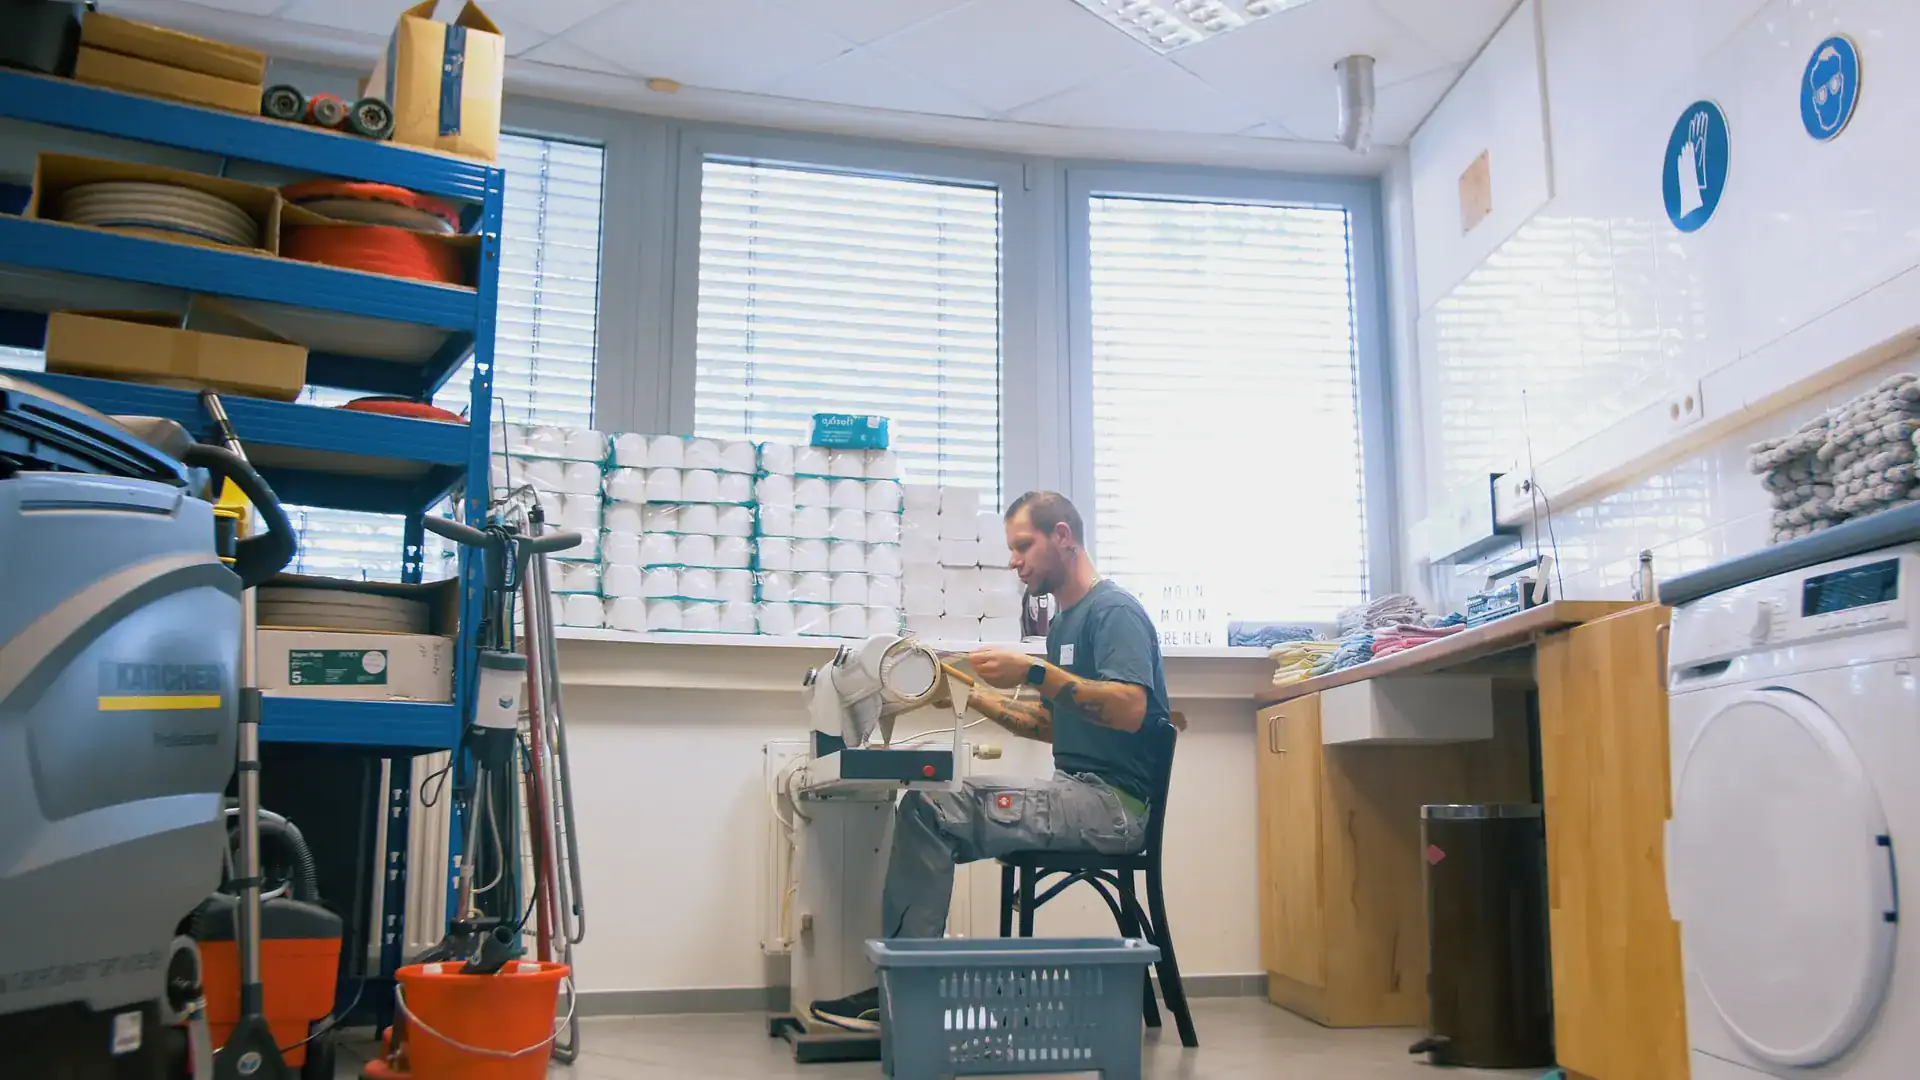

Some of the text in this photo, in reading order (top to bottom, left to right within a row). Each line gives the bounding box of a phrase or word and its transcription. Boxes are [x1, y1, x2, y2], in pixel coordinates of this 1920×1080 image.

[1163, 584, 1204, 600] MOIN
[1160, 608, 1206, 623] MOIN
[1157, 631, 1212, 646] BREMEN
[291, 671, 302, 683] 5
